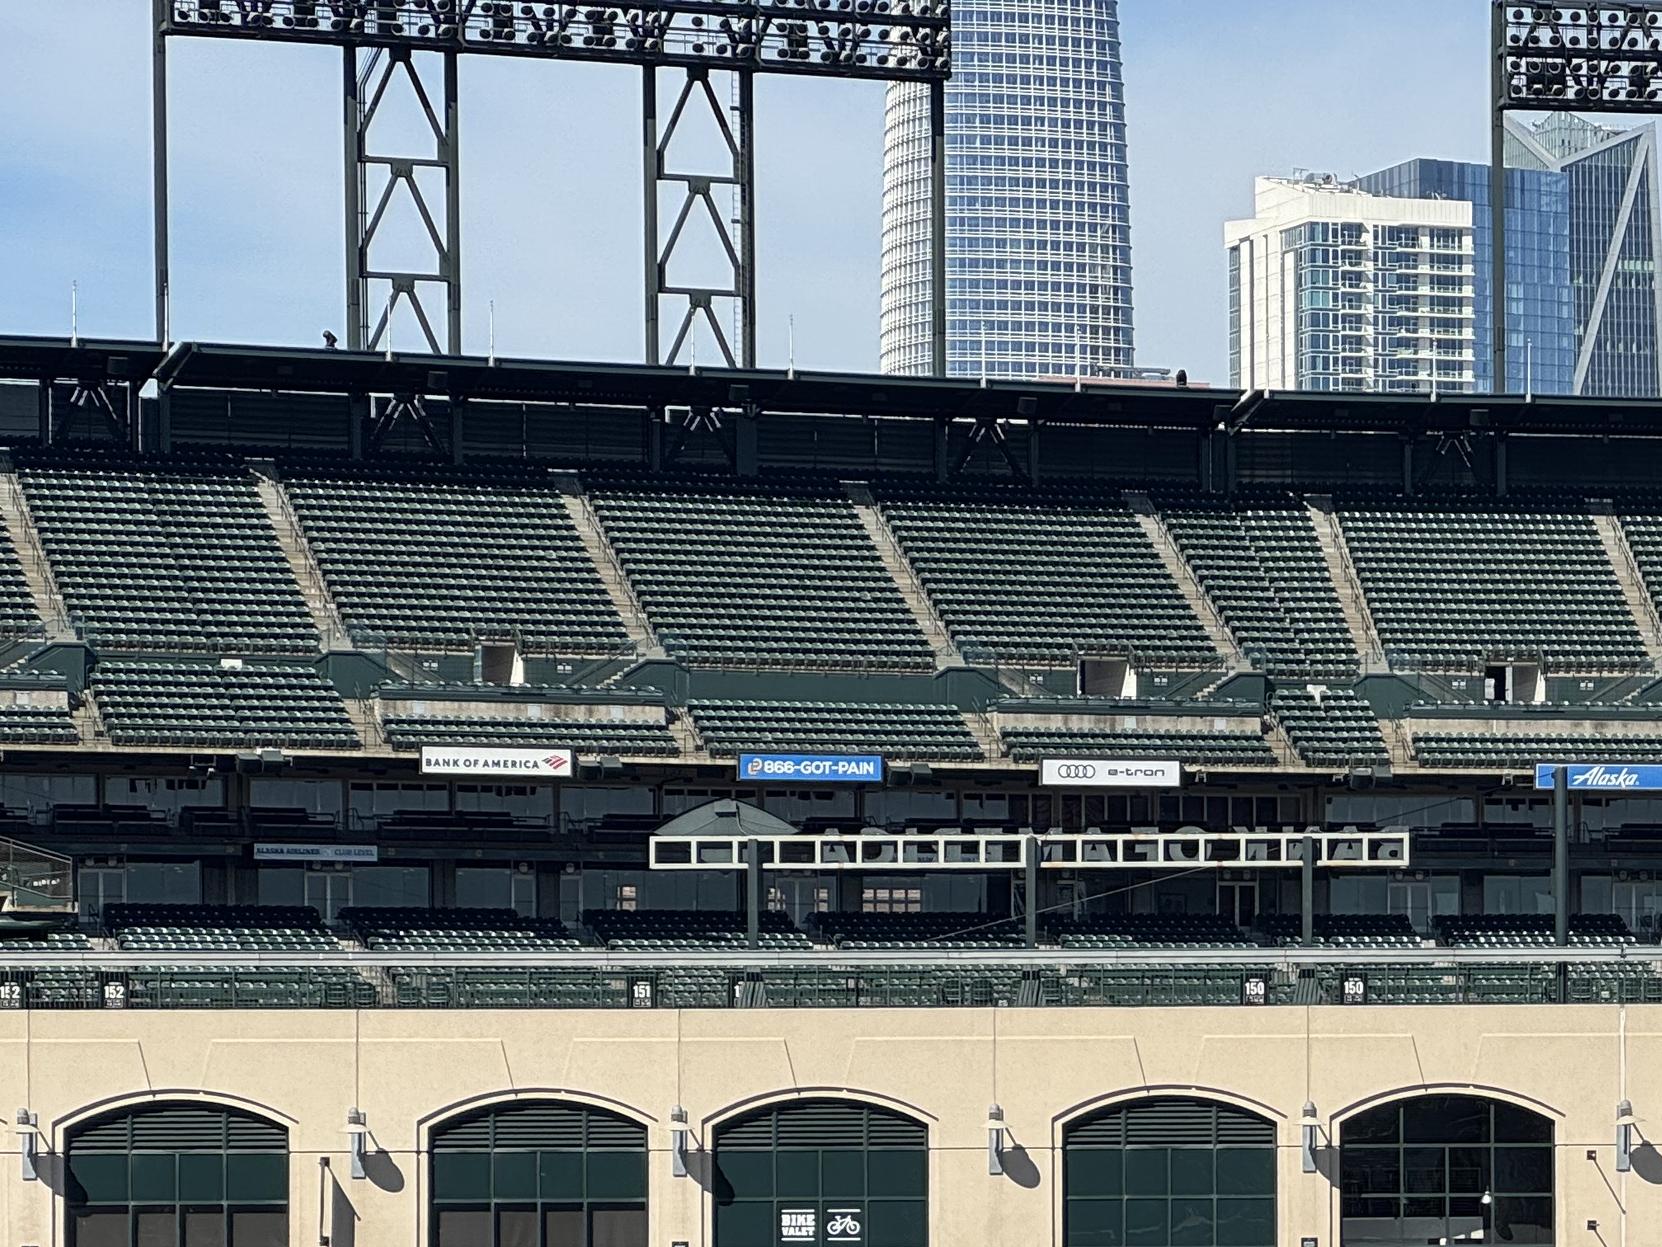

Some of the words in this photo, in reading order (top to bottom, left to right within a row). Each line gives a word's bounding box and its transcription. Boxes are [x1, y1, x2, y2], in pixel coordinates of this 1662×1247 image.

[425, 758, 460, 768] BANK
[463, 758, 479, 768] OF
[482, 759, 540, 770] AMERICA
[764, 760, 874, 774] 866-GOT-PAIN
[1108, 768, 1165, 776] e-tron
[1572, 766, 1639, 788] Alaska
[104, 986, 124, 998] 152
[633, 985, 651, 998] 151
[1245, 982, 1265, 994] 150
[1344, 982, 1364, 994] 150
[782, 1214, 816, 1226] BIKE
[782, 1226, 816, 1236] VALET
